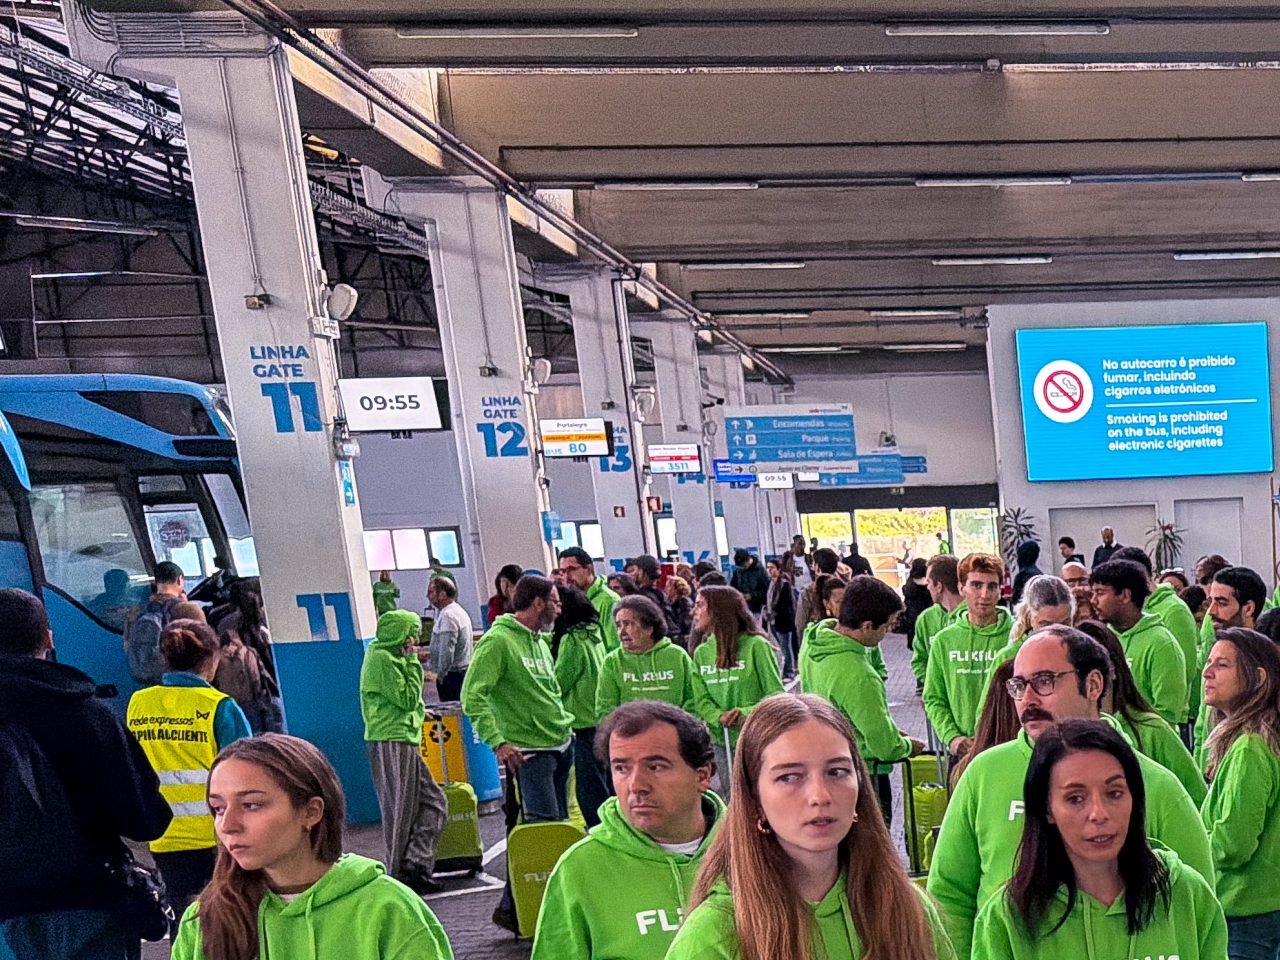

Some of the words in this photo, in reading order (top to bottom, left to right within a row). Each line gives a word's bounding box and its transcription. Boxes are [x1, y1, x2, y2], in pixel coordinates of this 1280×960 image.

[250, 345, 310, 359] LINHA
[1102, 359, 1119, 370] No
[1120, 357, 1177, 369] autocarro
[1179, 356, 1187, 367] é
[1188, 355, 1236, 370] proibido
[253, 364, 304, 378] GATE
[1103, 371, 1142, 383] fumar,
[1143, 370, 1197, 382] incluindo
[1104, 385, 1152, 399] cigarros
[1153, 383, 1217, 396] eletrónicos
[261, 381, 323, 433] 11
[359, 394, 421, 411] 09:55
[481, 396, 522, 407] LINHA
[483, 409, 518, 419] GATE
[1106, 413, 1157, 426] Smoking
[1158, 412, 1168, 424] is
[1170, 410, 1228, 426] prohibited
[772, 419, 825, 429] Encomendas
[1107, 428, 1123, 438] on
[1124, 426, 1144, 437] the
[1145, 425, 1169, 437] bus,
[1170, 424, 1224, 436] including
[476, 421, 529, 458] 12
[801, 434, 829, 443] Parque
[1108, 439, 1165, 451] electronic
[1166, 437, 1224, 451] cigarettes
[568, 443, 587, 453] 80
[777, 449, 796, 458] Sala
[796, 450, 807, 458] de
[807, 449, 834, 458] Espera
[600, 446, 632, 472] 13
[295, 592, 340, 641] 11
[129, 715, 149, 727] rede
[149, 716, 195, 727] expressos
